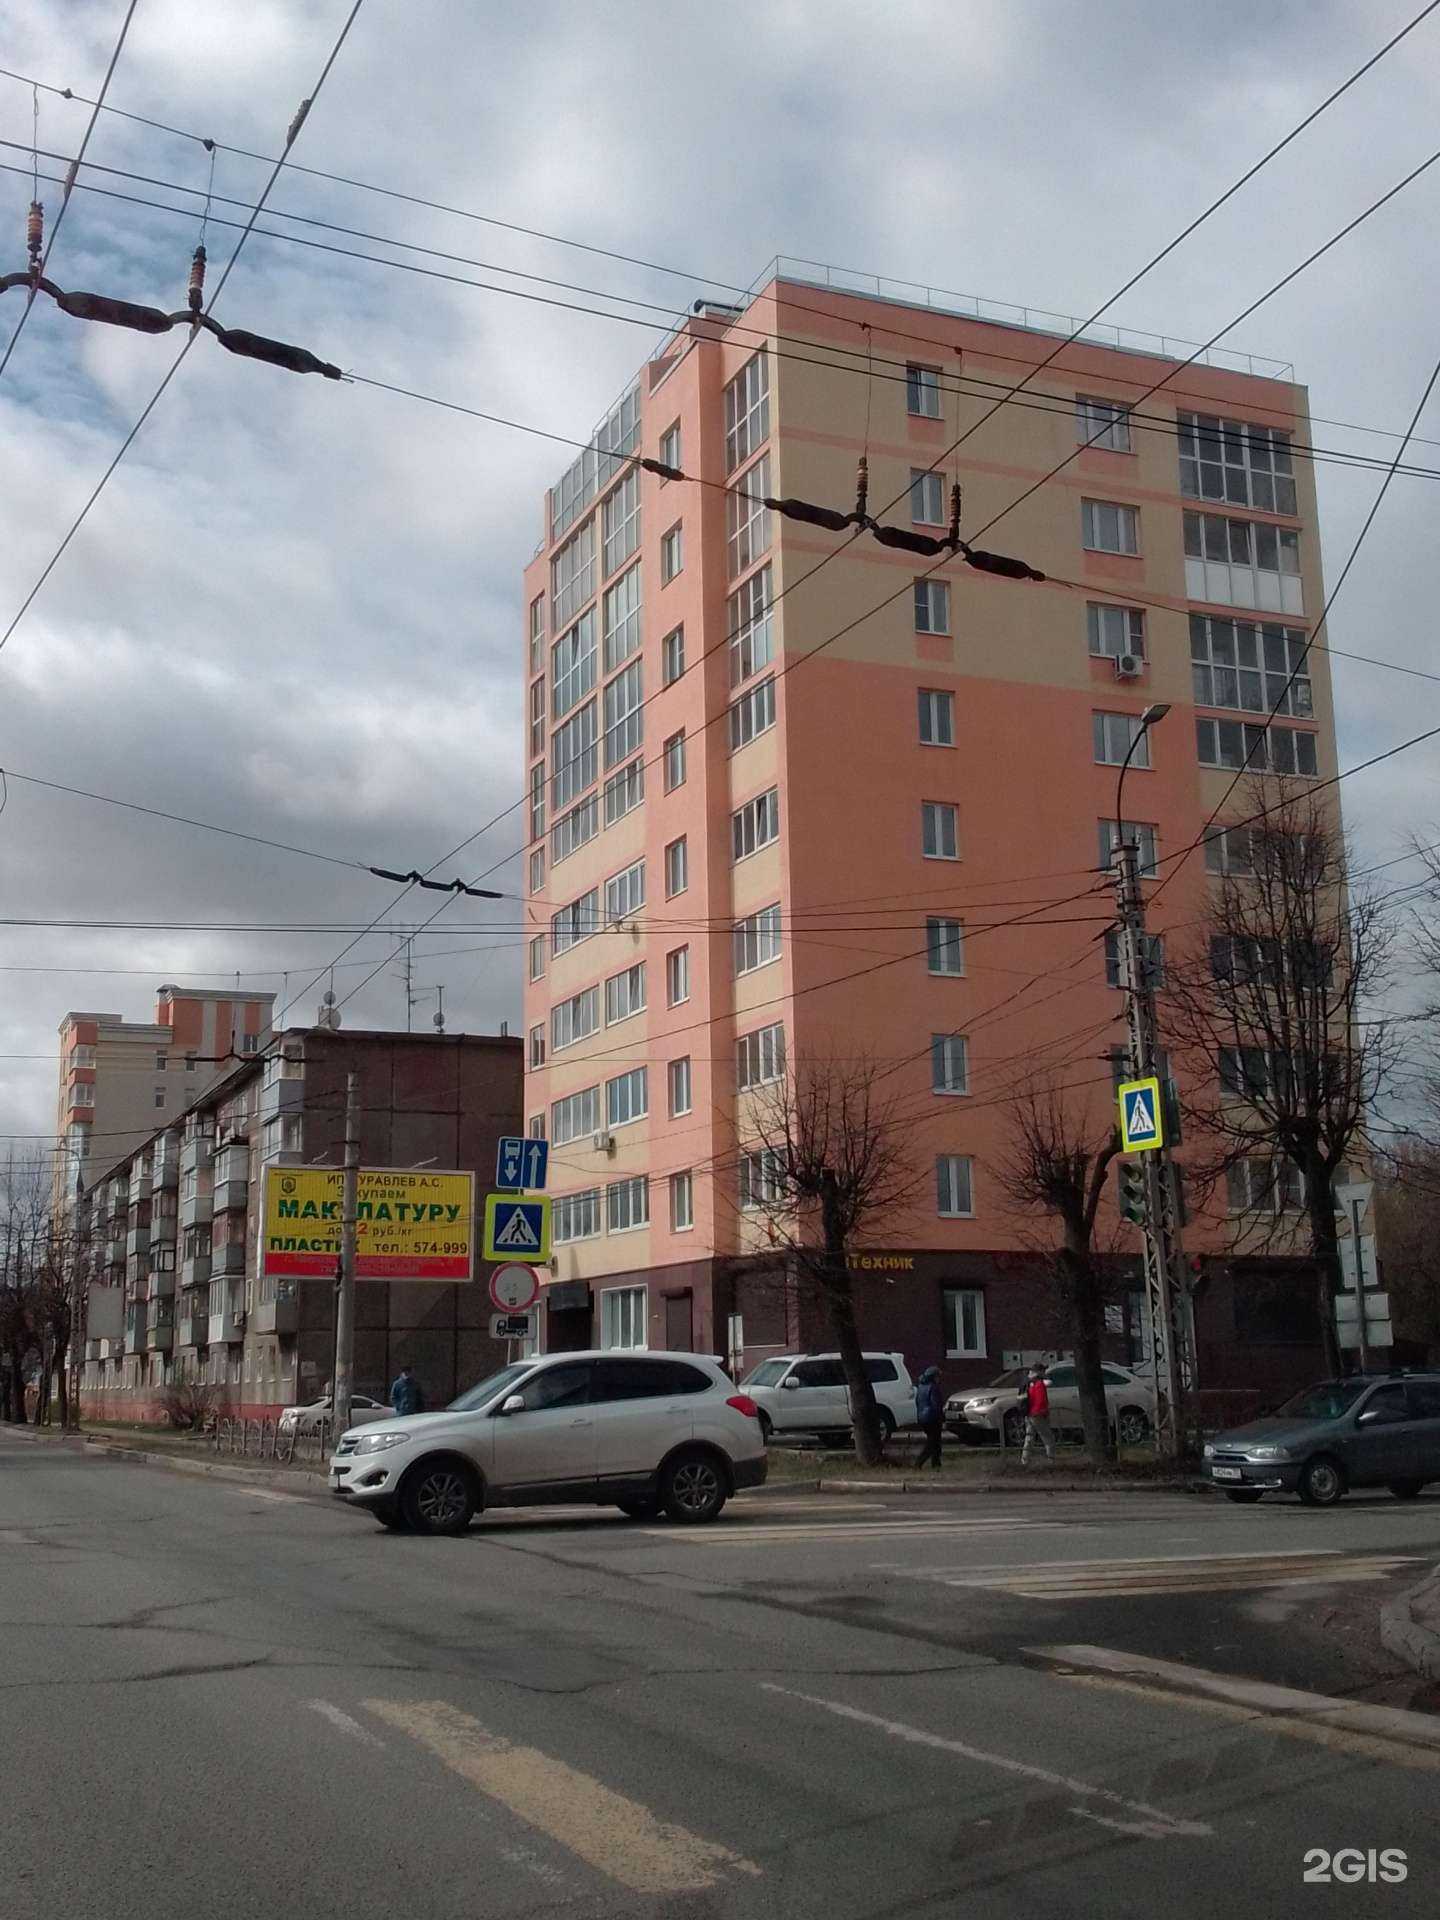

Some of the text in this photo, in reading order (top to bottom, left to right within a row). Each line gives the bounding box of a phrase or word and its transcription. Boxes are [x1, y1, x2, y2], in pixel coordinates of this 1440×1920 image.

[327, 1174, 345, 1185] ИП
[358, 1174, 417, 1188] УРАВЛЕВ
[278, 1199, 461, 1223] МАКЛАТУРУ
[326, 1226, 343, 1237] до
[413, 1241, 468, 1255] 574-999
